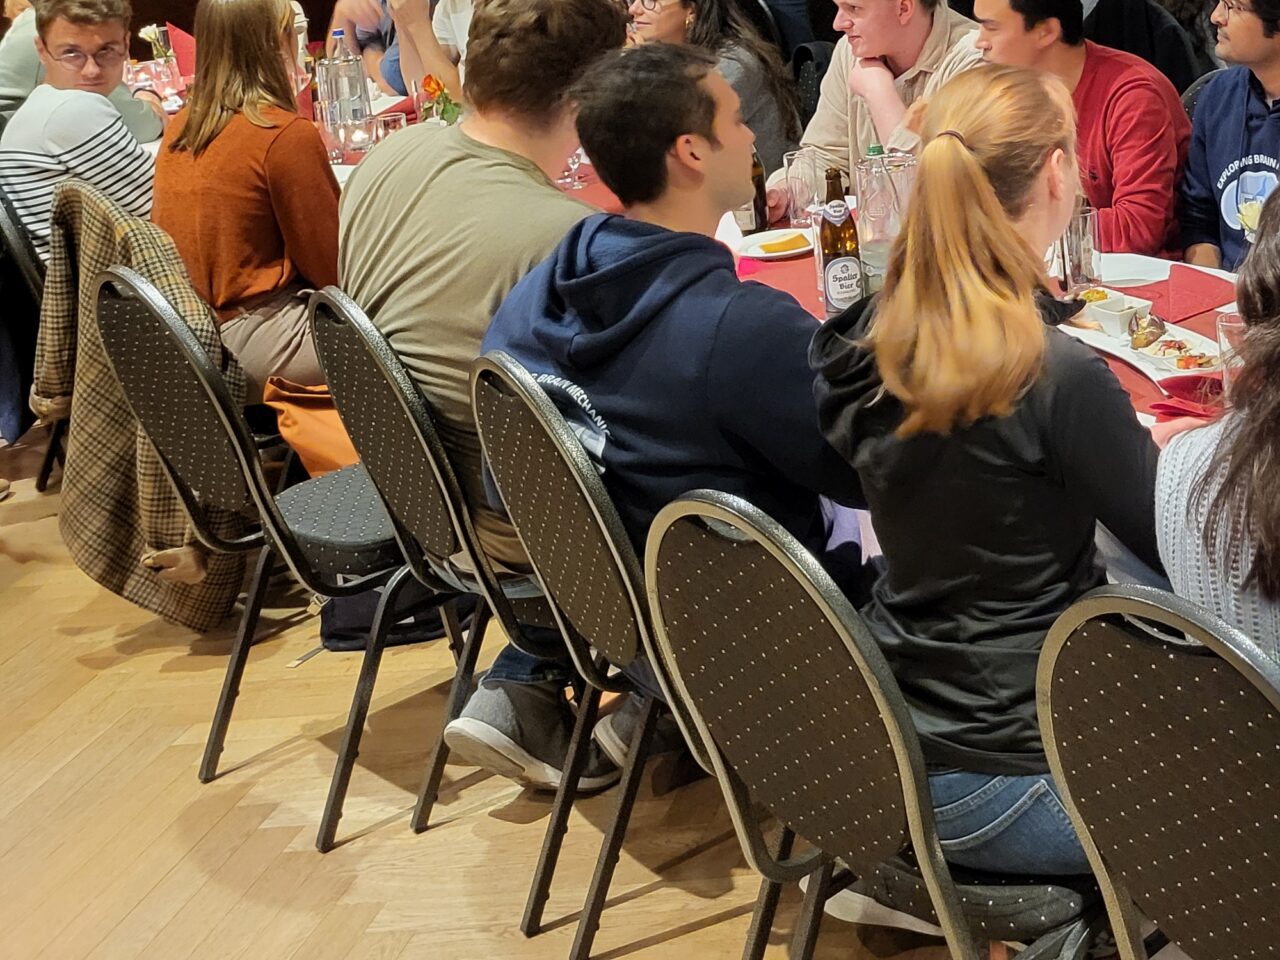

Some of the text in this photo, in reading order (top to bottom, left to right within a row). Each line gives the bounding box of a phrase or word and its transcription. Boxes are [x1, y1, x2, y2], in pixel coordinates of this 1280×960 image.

[1253, 154, 1277, 168] BRAIN
[839, 282, 854, 290] Bier
[537, 373, 573, 390] BRAIN
